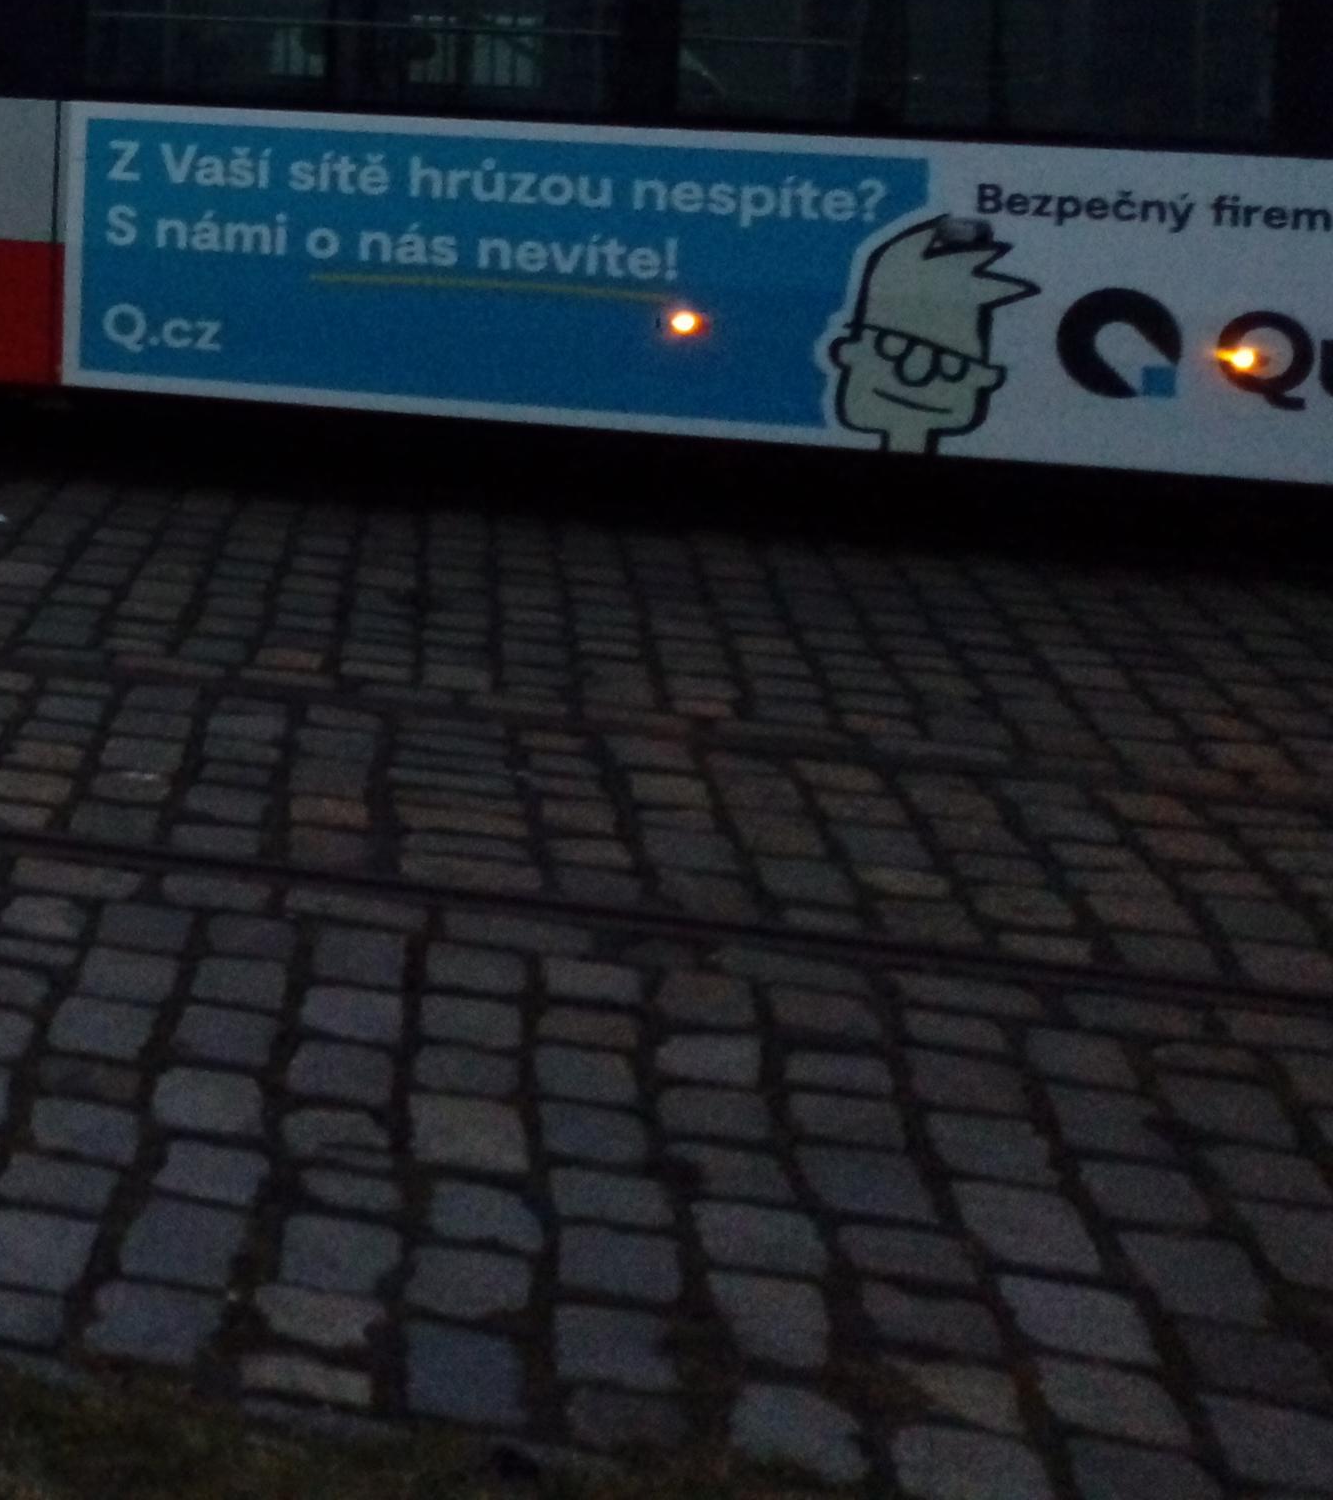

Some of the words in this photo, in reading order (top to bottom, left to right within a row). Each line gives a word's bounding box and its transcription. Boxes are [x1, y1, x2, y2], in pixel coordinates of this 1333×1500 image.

[107, 140, 142, 182] Z
[160, 142, 273, 190] Vaší
[288, 150, 390, 196] sítě
[408, 156, 614, 209] hrůzou
[631, 174, 887, 228] nespíte?
[976, 182, 1194, 234] Bezpečný
[1212, 194, 1332, 232] firem
[106, 204, 138, 247] S
[155, 211, 289, 257] námi
[305, 226, 341, 260] o
[359, 222, 459, 268] nás
[477, 232, 679, 281] nevíte!
[102, 303, 223, 353] Q.cz
